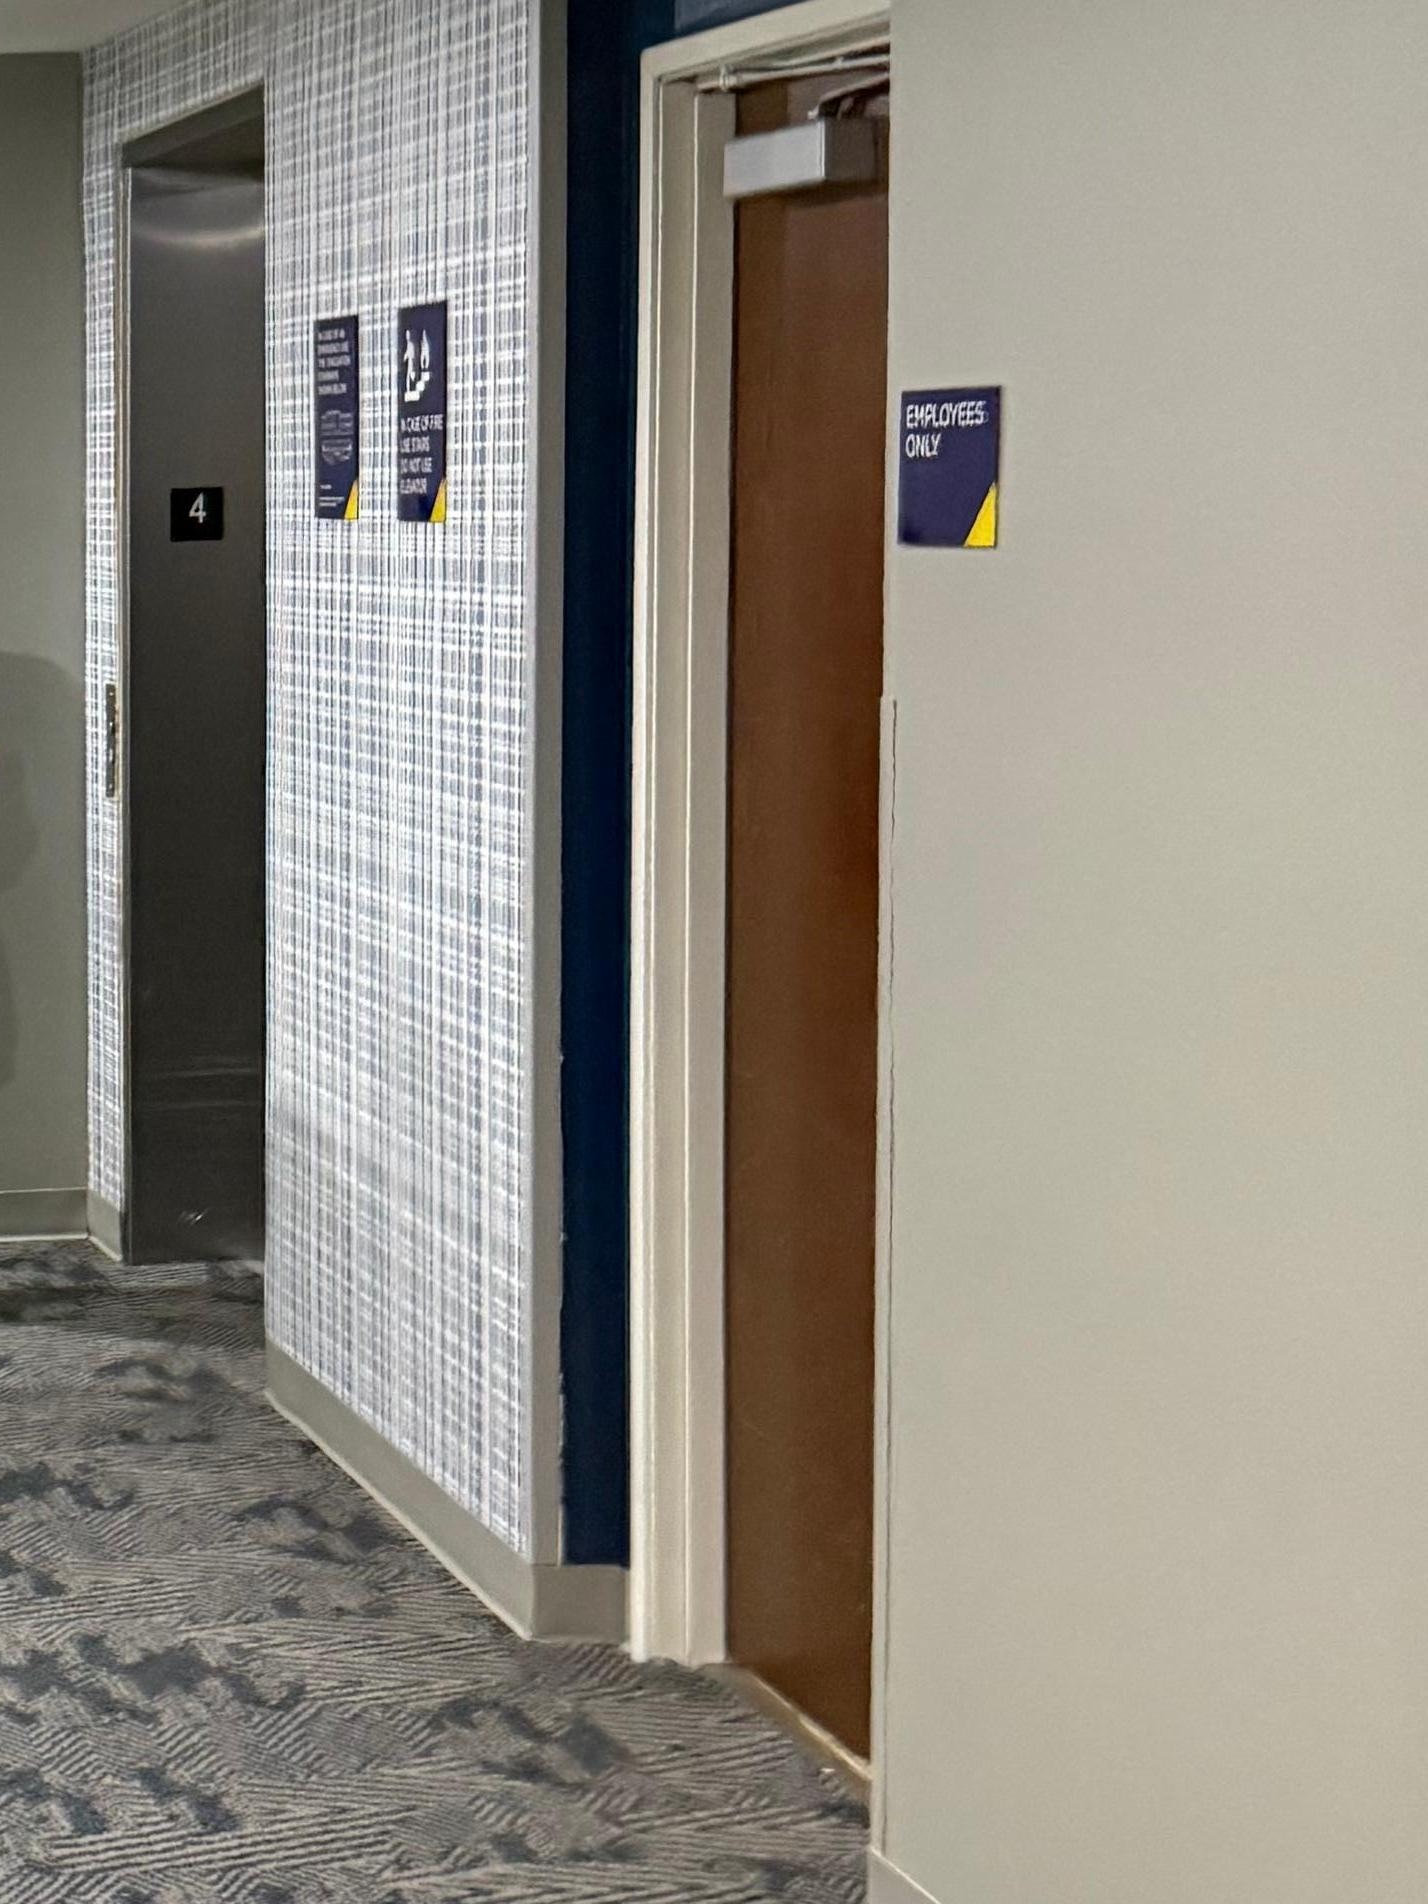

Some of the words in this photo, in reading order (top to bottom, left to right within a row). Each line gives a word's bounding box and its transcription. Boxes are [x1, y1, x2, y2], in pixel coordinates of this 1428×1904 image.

[906, 401, 987, 428] EMPLOYEES
[905, 433, 941, 457] ONLY
[189, 492, 206, 523] 4
